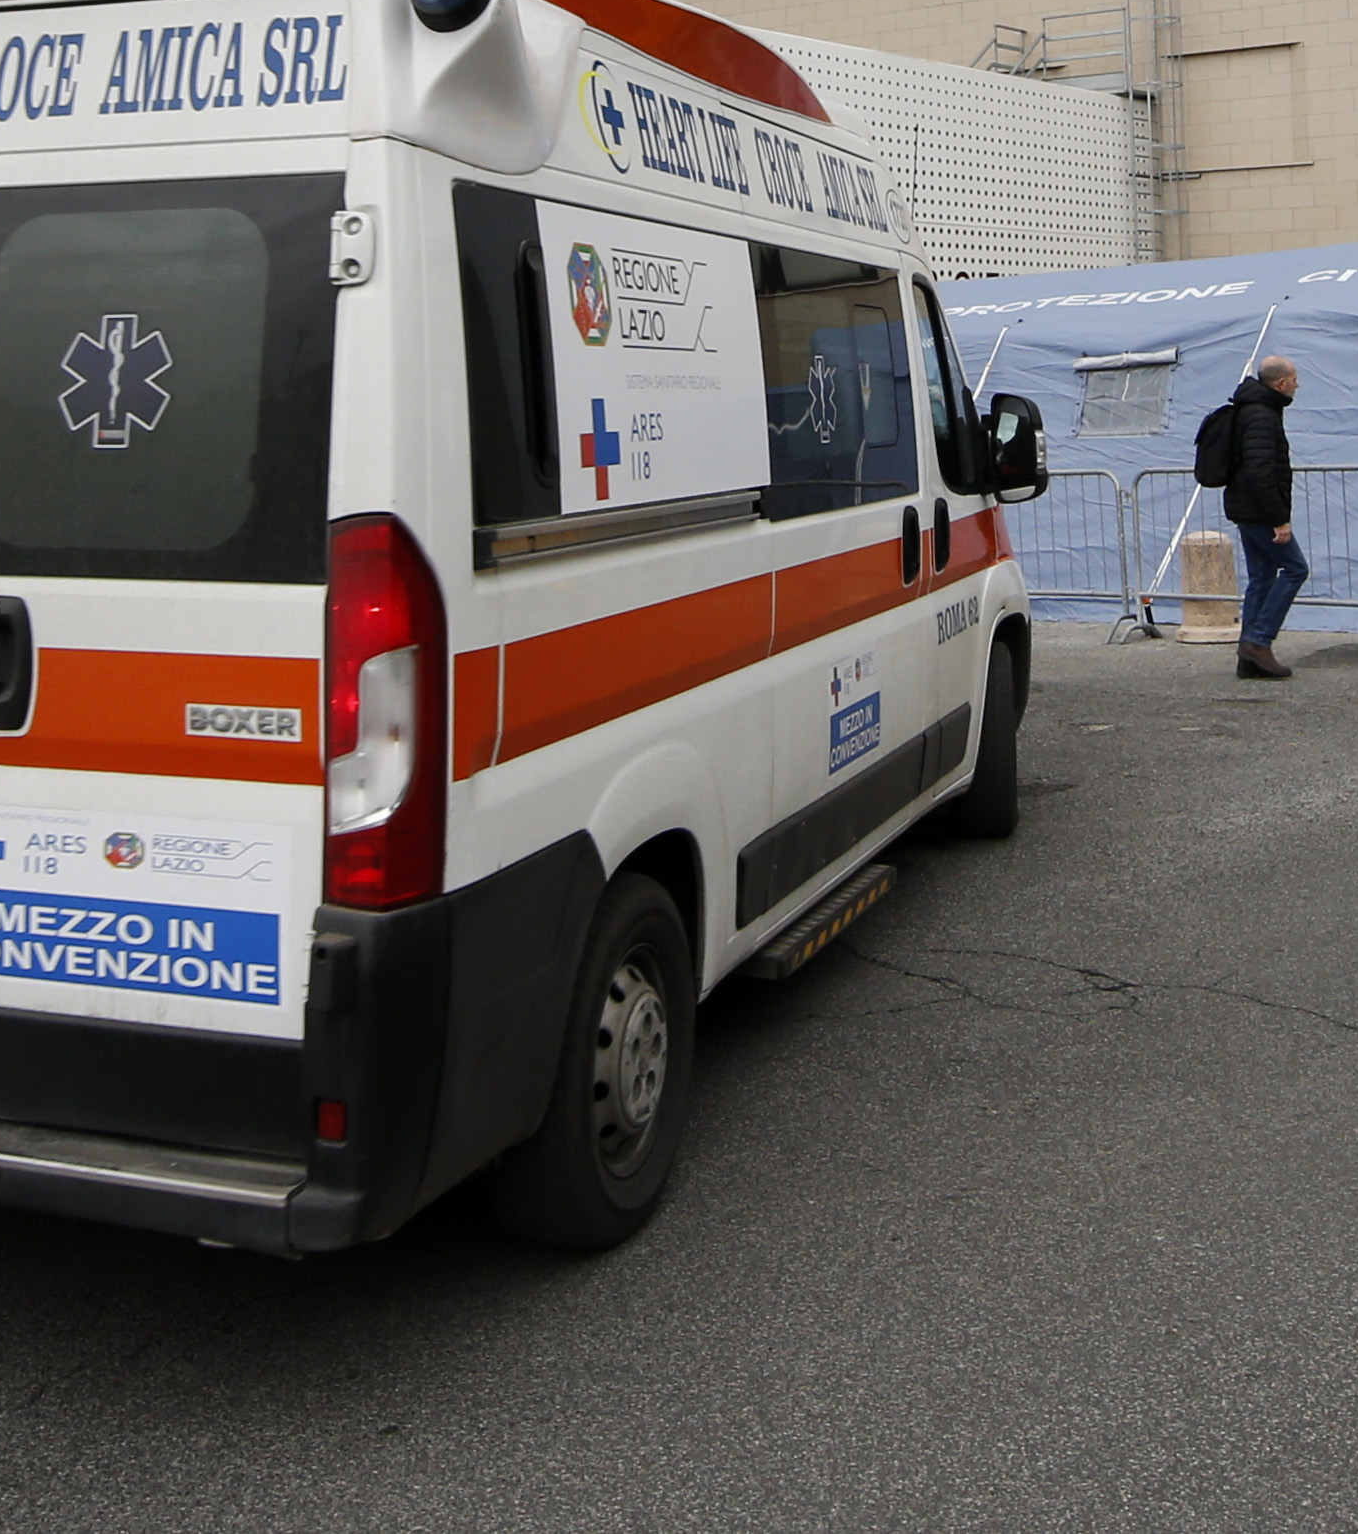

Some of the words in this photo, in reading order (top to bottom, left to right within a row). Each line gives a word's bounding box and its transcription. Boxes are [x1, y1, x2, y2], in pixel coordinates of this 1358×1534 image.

[98, 20, 244, 116] AMICA
[257, 14, 349, 108] SRL
[626, 80, 706, 184] HEART
[697, 107, 751, 196] LIFE
[754, 126, 814, 213] CROCE
[612, 256, 681, 295] REGIONE
[944, 280, 1255, 317] PROTEZIONE
[618, 307, 666, 342] LAZIO
[630, 413, 663, 443] ARES
[630, 451, 651, 481] 118
[936, 600, 967, 645] ROMA
[968, 595, 979, 626] 62
[188, 707, 298, 737] BOXER
[839, 707, 864, 739] MEZZO
[24, 832, 87, 855] ARES
[152, 837, 231, 856] REGIONE
[22, 855, 59, 876] 118
[152, 855, 205, 872] LAZIO
[167, 918, 216, 953] IN
